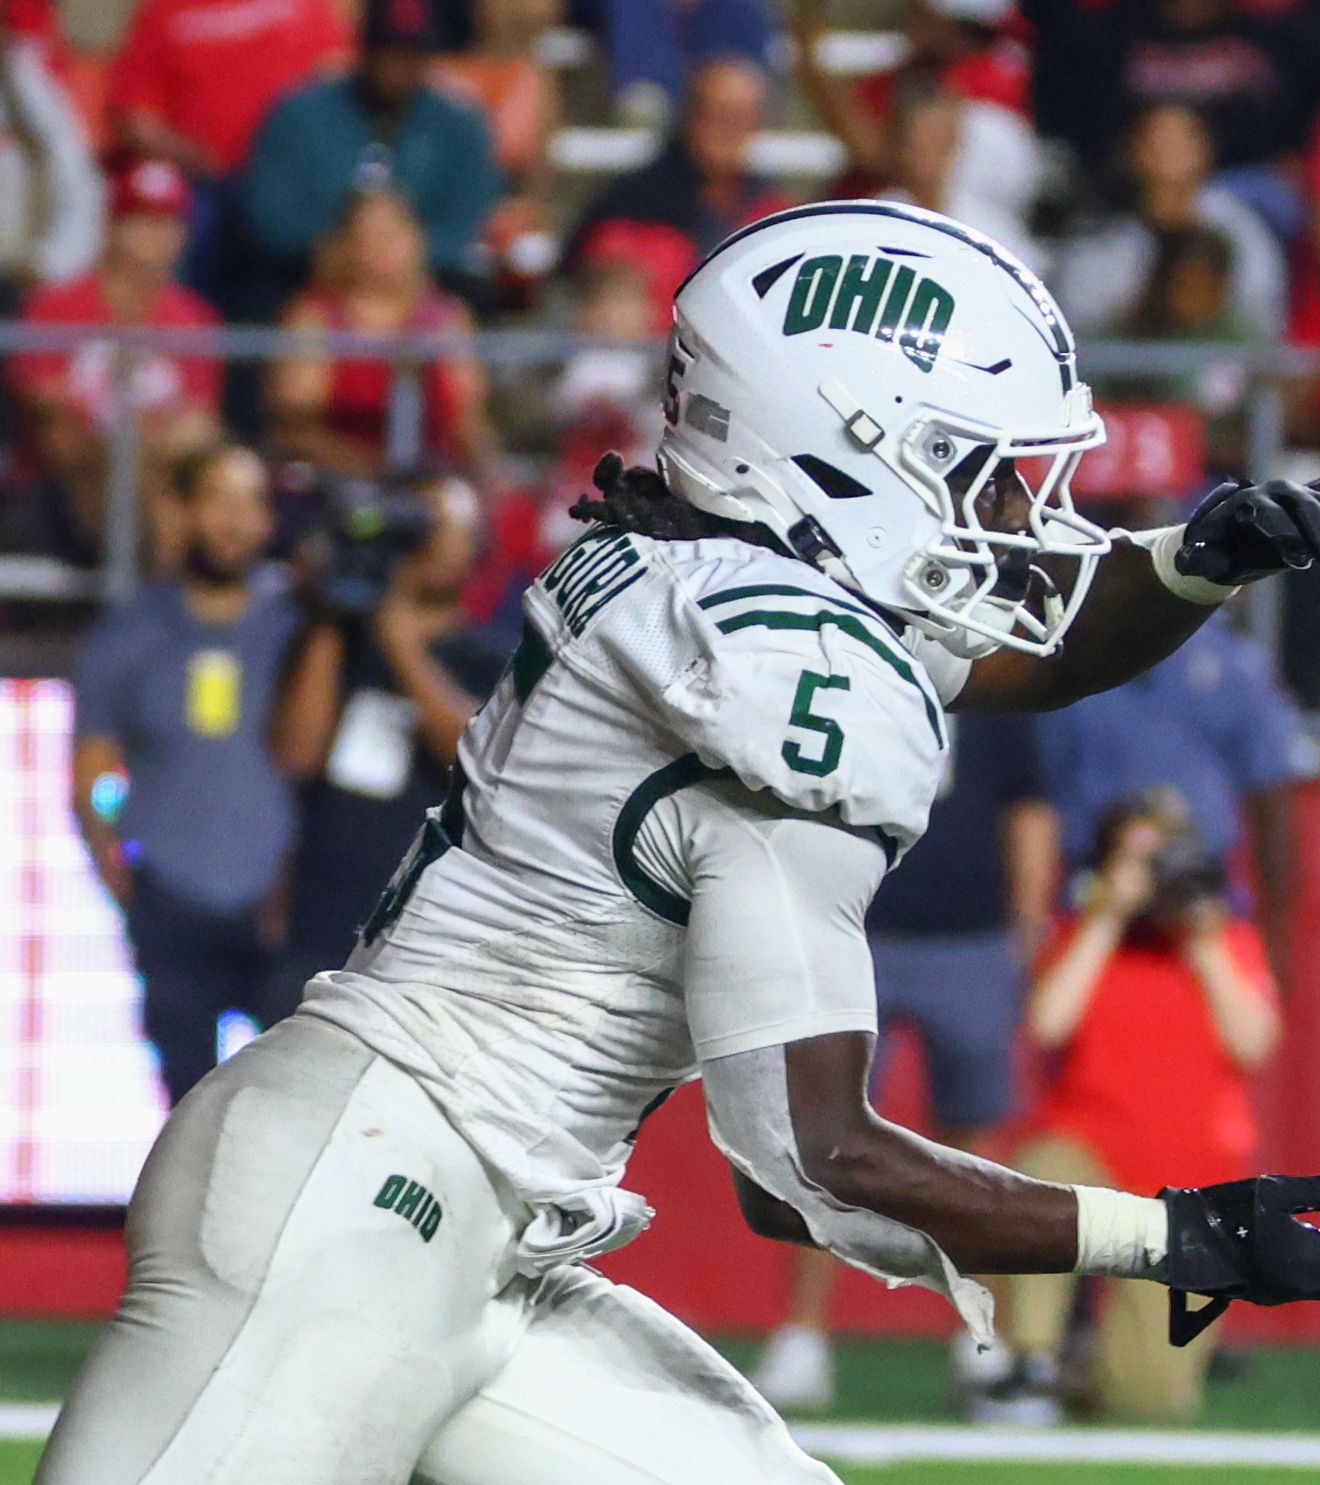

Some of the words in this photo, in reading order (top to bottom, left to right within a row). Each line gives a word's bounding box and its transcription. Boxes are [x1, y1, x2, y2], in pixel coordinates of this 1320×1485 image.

[783, 254, 955, 374] OHIO
[780, 668, 851, 778] 5
[372, 1173, 443, 1244] OHIO
